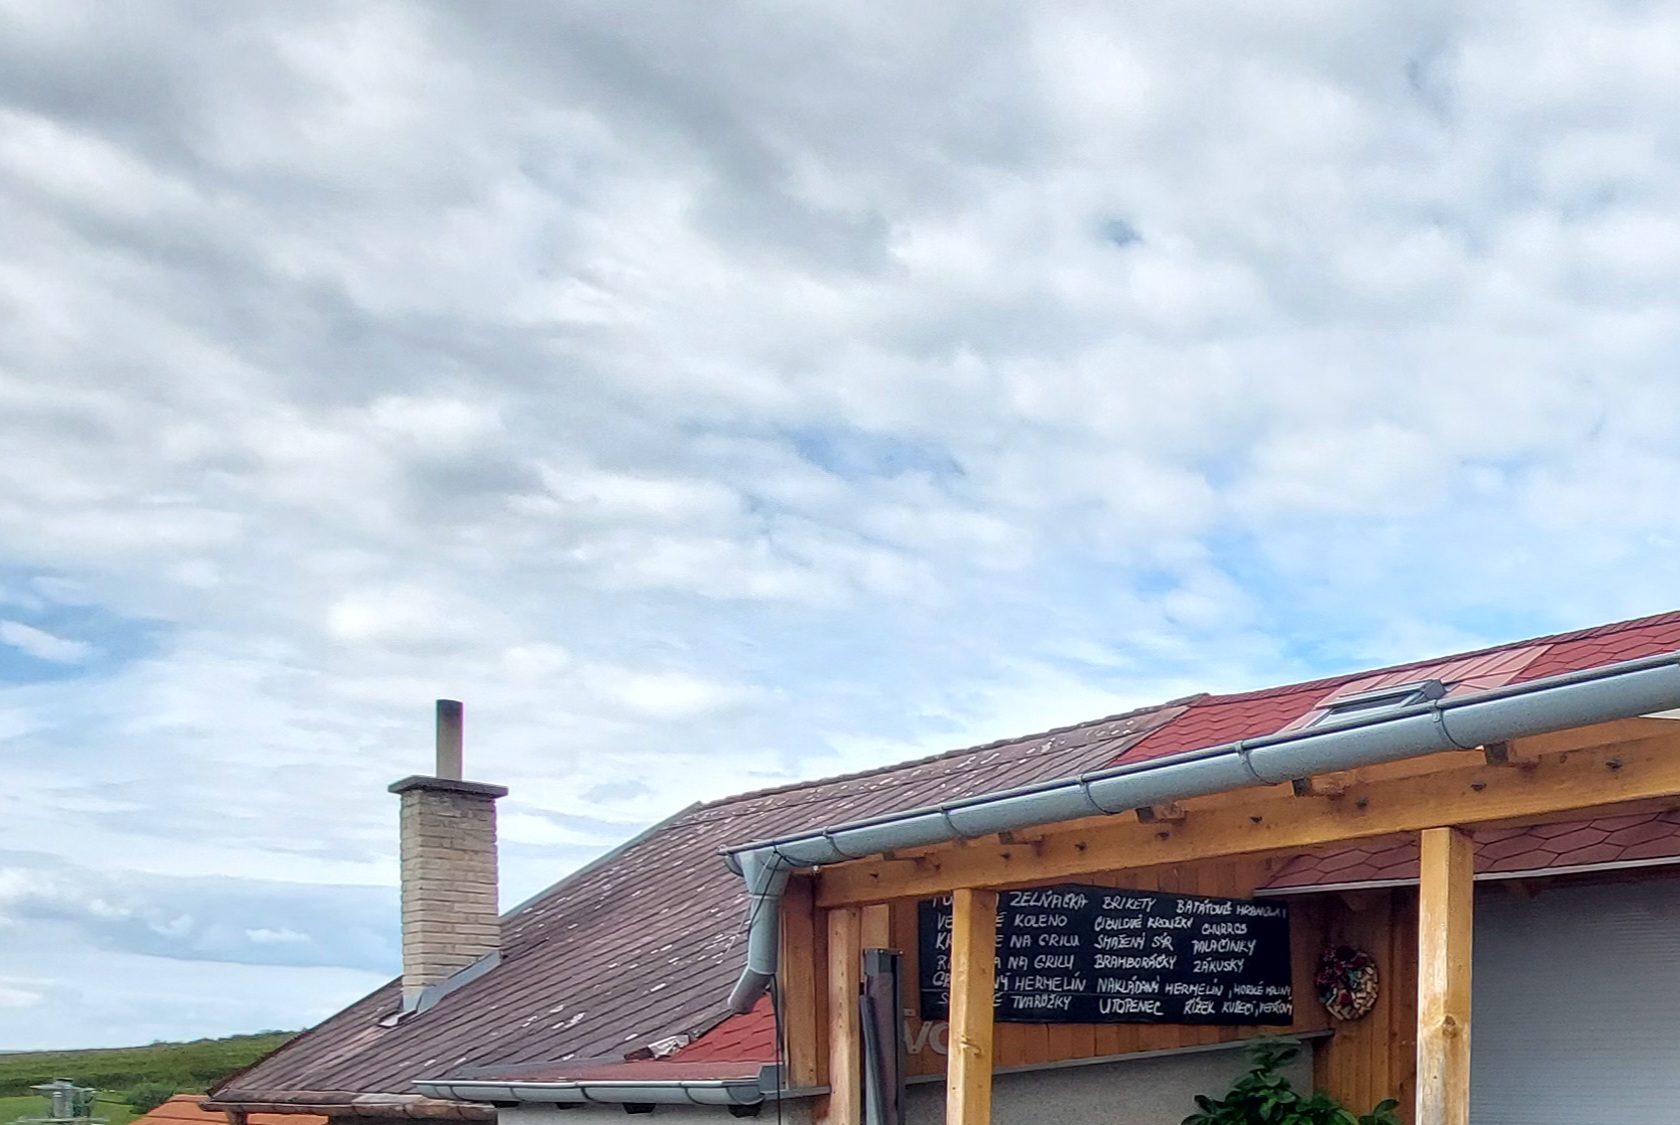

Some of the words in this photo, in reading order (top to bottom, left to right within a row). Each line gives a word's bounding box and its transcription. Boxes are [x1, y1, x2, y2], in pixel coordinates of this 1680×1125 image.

[1014, 913, 1068, 928] KOLENO
[1010, 934, 1032, 948] NA
[1007, 955, 1028, 971] NA
[1034, 955, 1075, 970] GRILU
[1014, 972, 1088, 992] HERMELÍN
